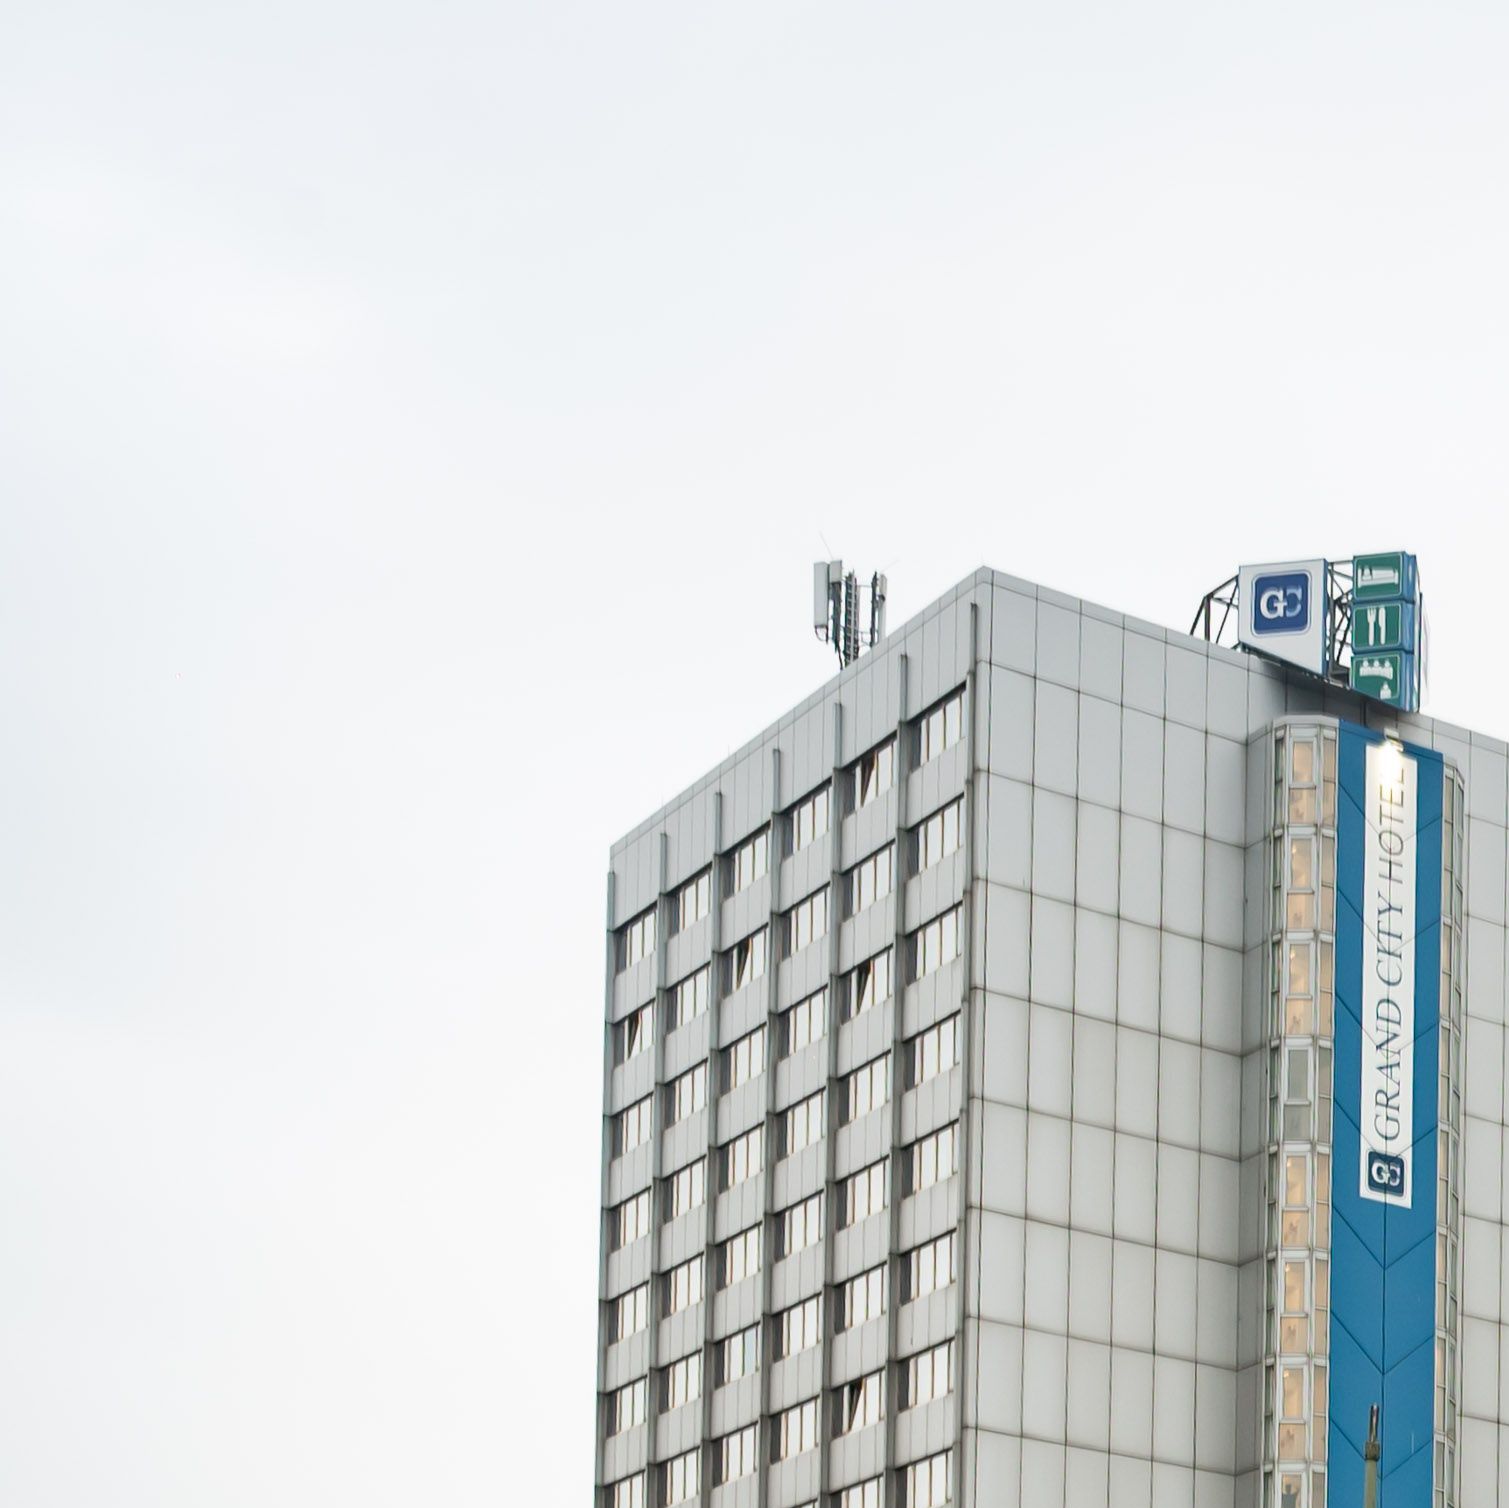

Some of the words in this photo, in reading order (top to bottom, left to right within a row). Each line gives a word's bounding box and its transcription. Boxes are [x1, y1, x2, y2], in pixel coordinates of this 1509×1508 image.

[1378, 767, 1404, 884] HOTEL
[1375, 890, 1403, 987] CITY
[1374, 997, 1403, 1141] GRAND
